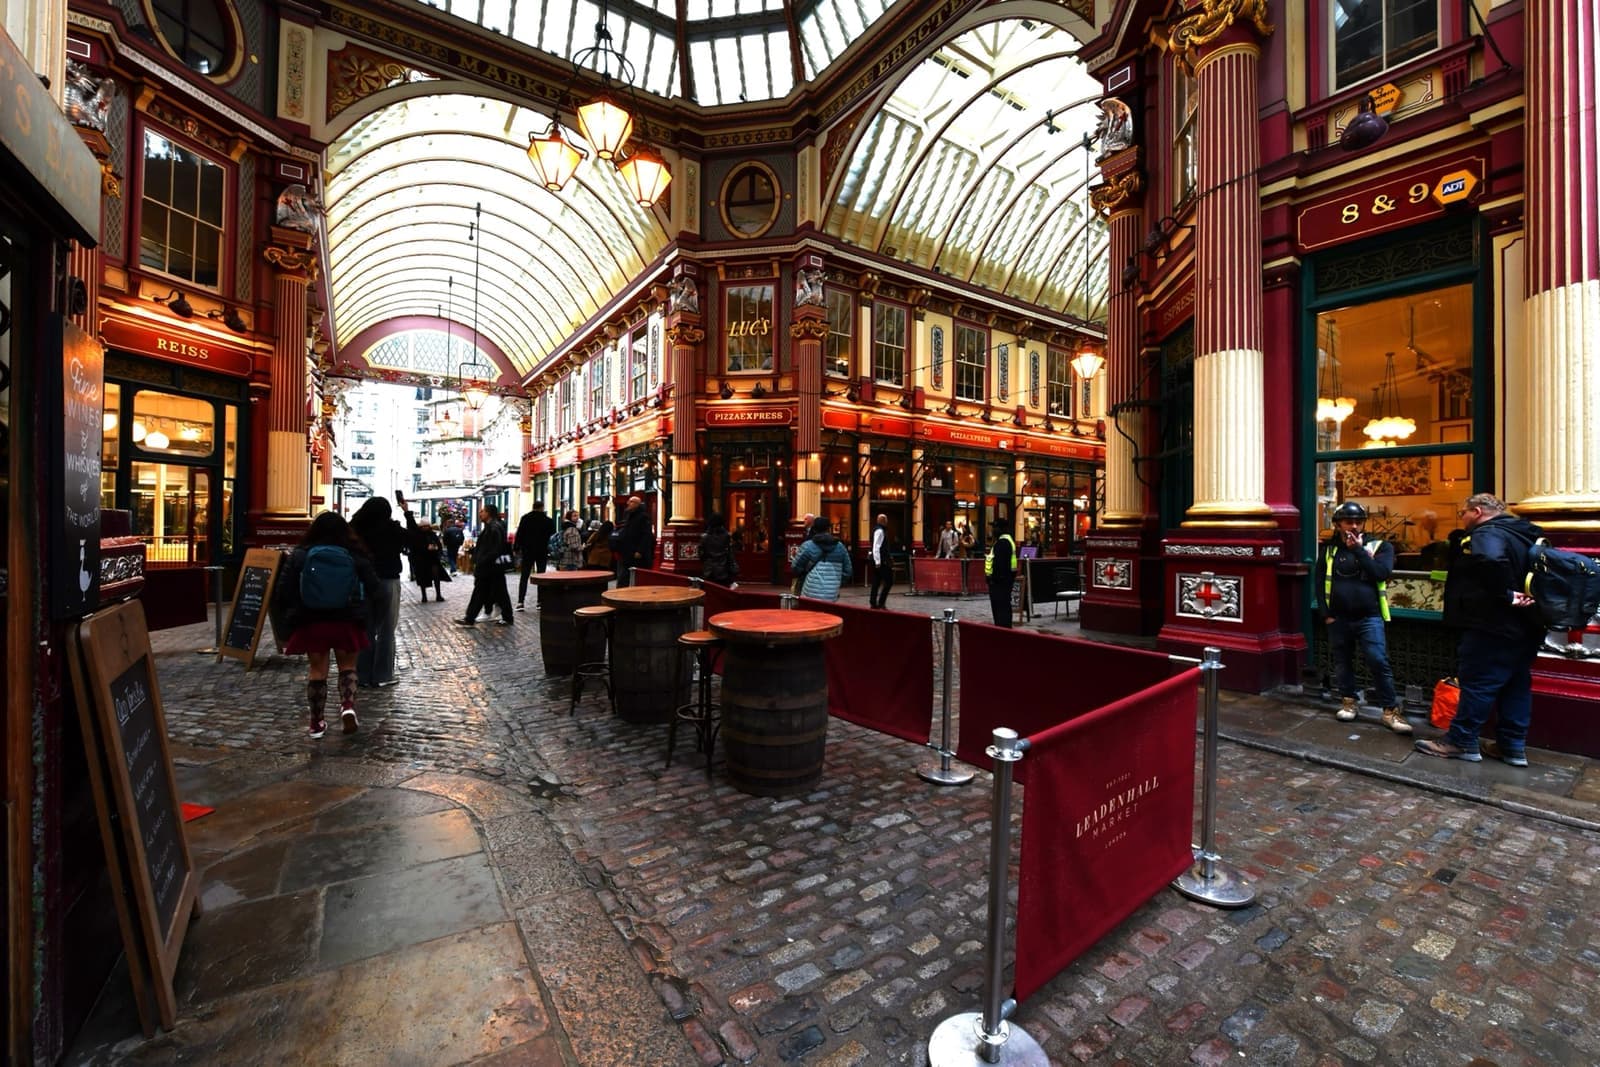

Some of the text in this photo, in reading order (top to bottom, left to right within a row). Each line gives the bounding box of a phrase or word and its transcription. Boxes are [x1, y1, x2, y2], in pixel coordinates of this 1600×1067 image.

[458, 52, 586, 112] MARKET
[1443, 181, 1465, 195] ADT
[1342, 182, 1430, 224] 8 & 9
[729, 316, 770, 337] LUC'S
[157, 337, 208, 359] REISS
[71, 357, 98, 401] Fine
[67, 399, 101, 429] WINES
[714, 411, 783, 421] PIZZAEXPRESS
[66, 453, 101, 478] WHISKIES
[66, 505, 79, 526] THE
[1075, 775, 1160, 839] LEADENHALL
[1092, 802, 1139, 841] MARKET
